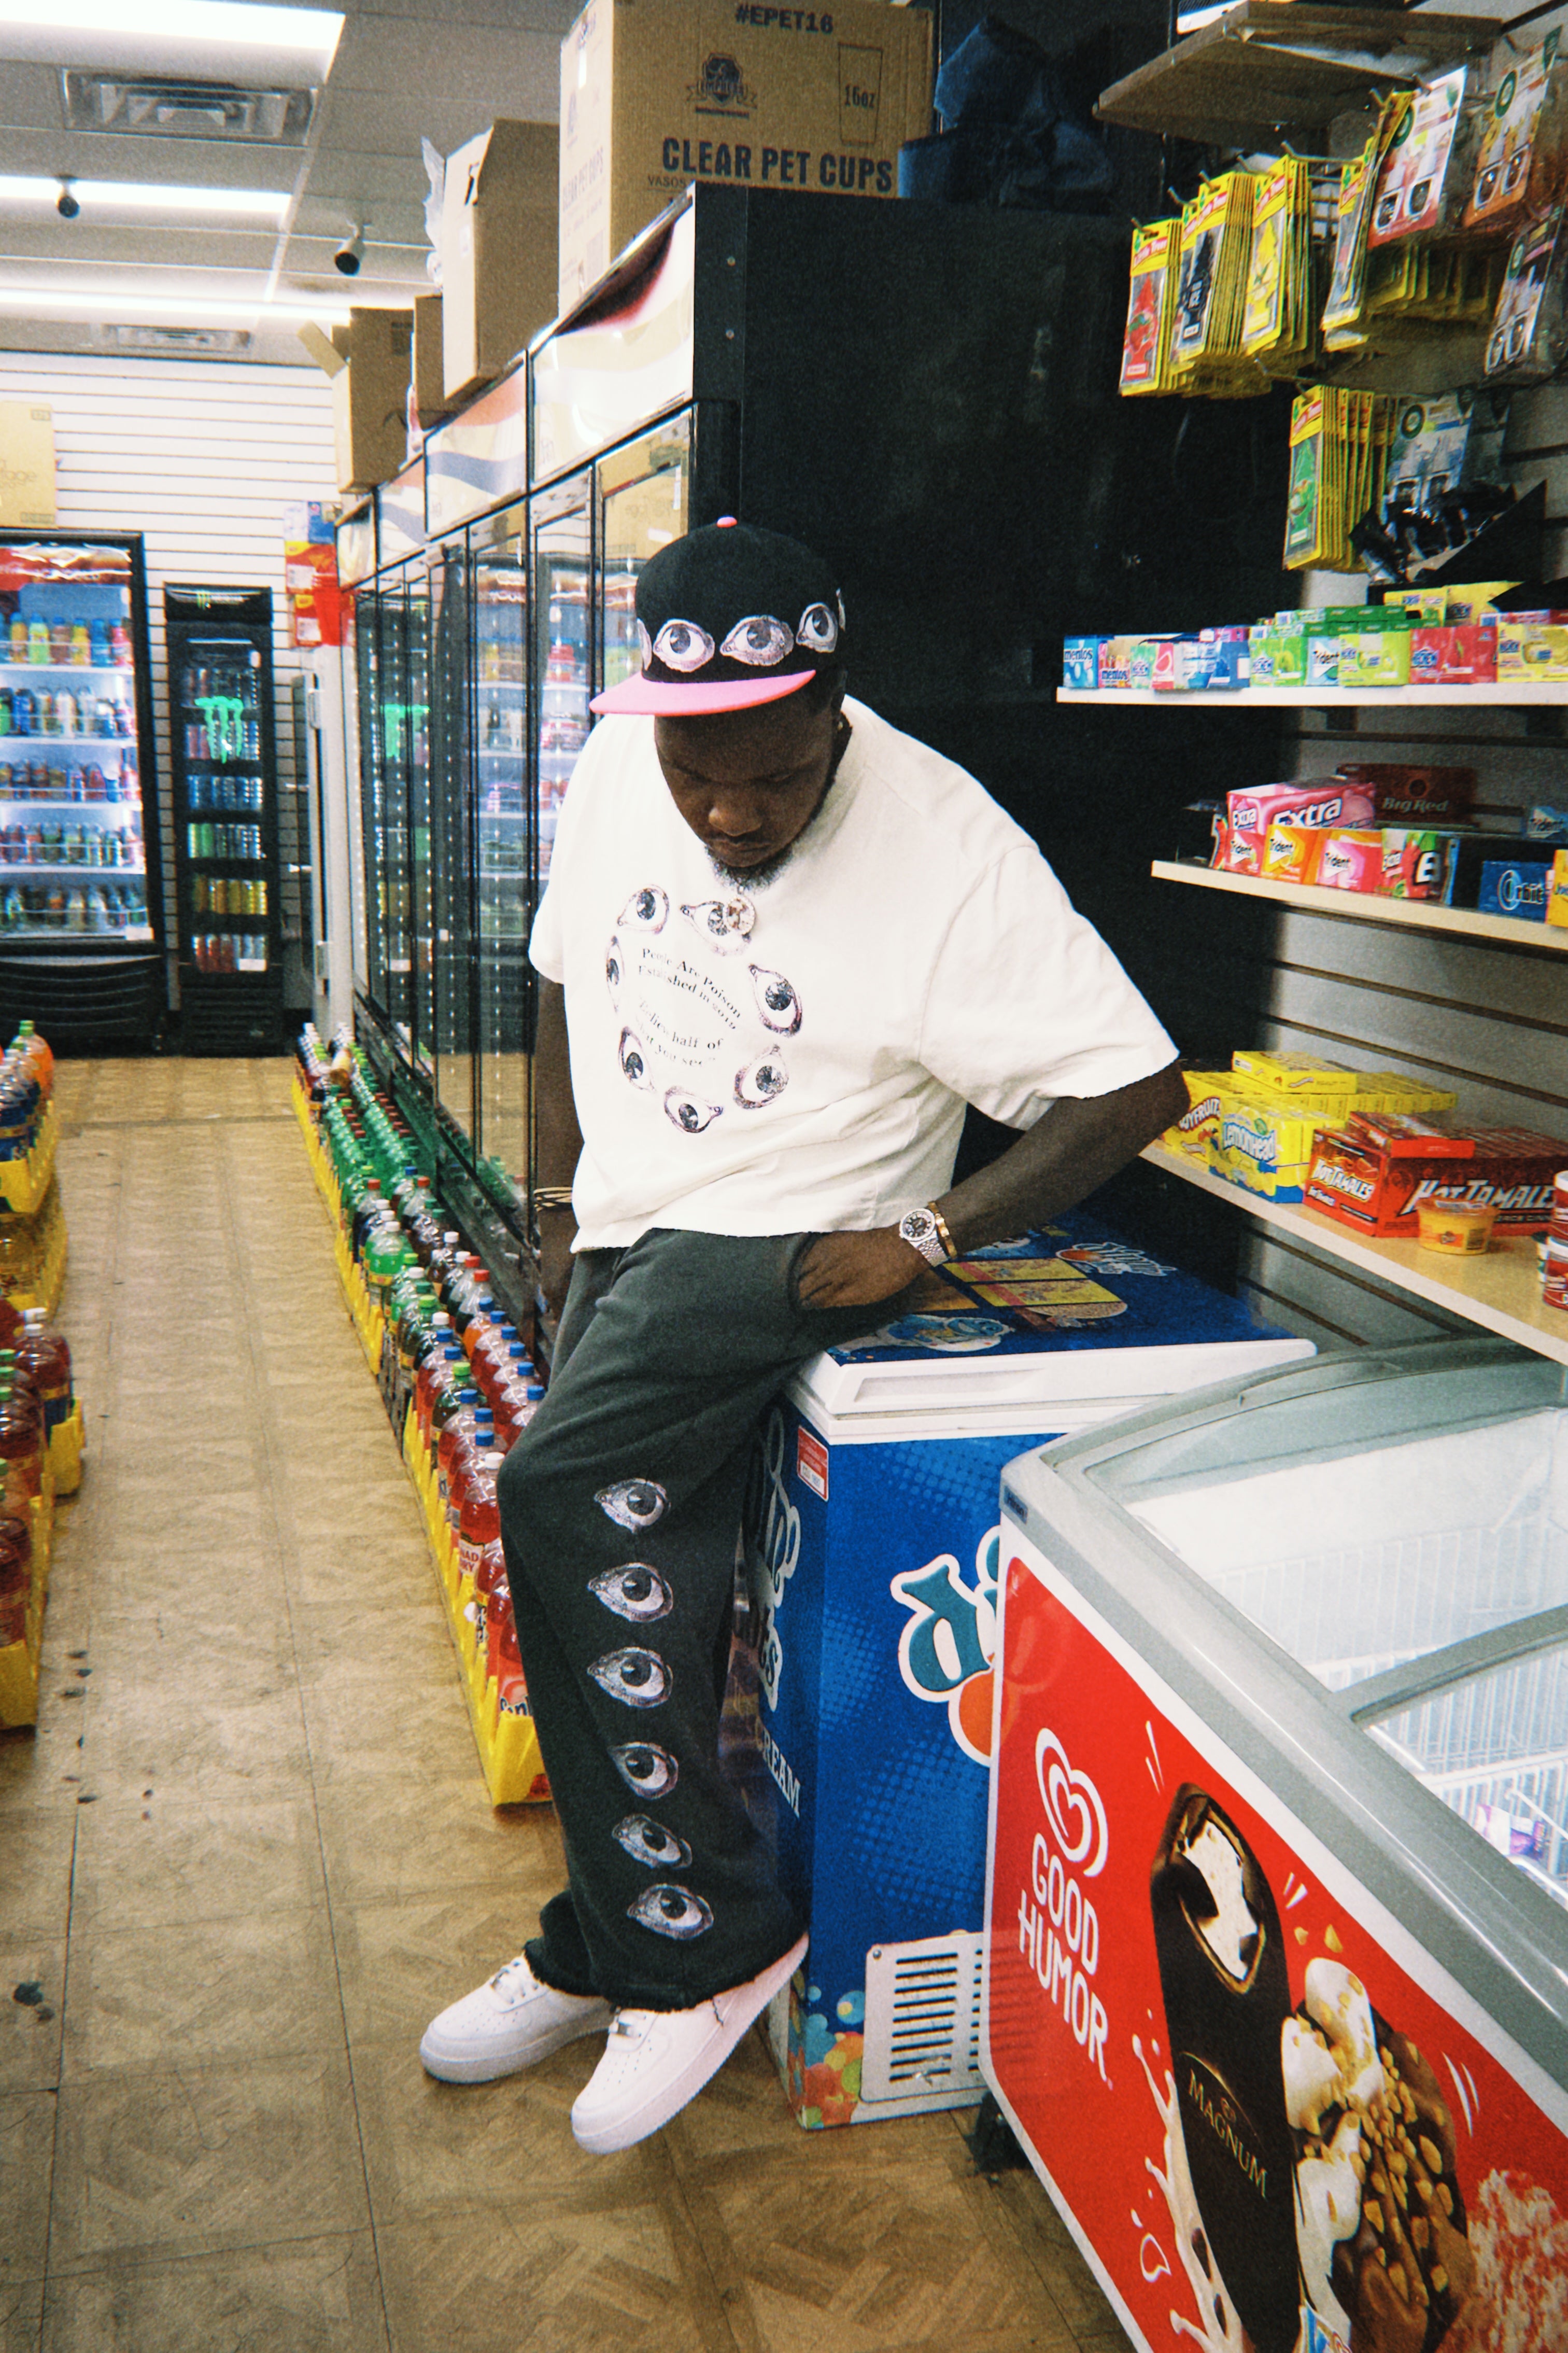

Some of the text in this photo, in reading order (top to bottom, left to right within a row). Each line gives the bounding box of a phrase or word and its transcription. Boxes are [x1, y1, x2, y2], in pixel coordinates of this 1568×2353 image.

[736, 5, 834, 34] #EPET16
[844, 85, 876, 109] 16oz
[663, 137, 893, 193] CLEAR PET CUPS
[1064, 649, 1093, 660] mentos
[1101, 669, 1128, 680] mentos
[1233, 808, 1256, 830] Extra
[1272, 797, 1343, 828] Extra
[1230, 838, 1252, 858] Trident
[1269, 837, 1294, 854] Trident
[1324, 852, 1351, 870] Trident
[1498, 869, 1546, 911] Orbit
[642, 948, 741, 1018] Peole Are Poison
[699, 989, 710, 1003] in
[672, 1031, 698, 1048] half
[707, 1038, 724, 1050] of
[1032, 1832, 1099, 1976] GOOD
[1018, 1889, 1108, 2081] HUMOR
[1188, 2068, 1268, 2200] MAGNUM
